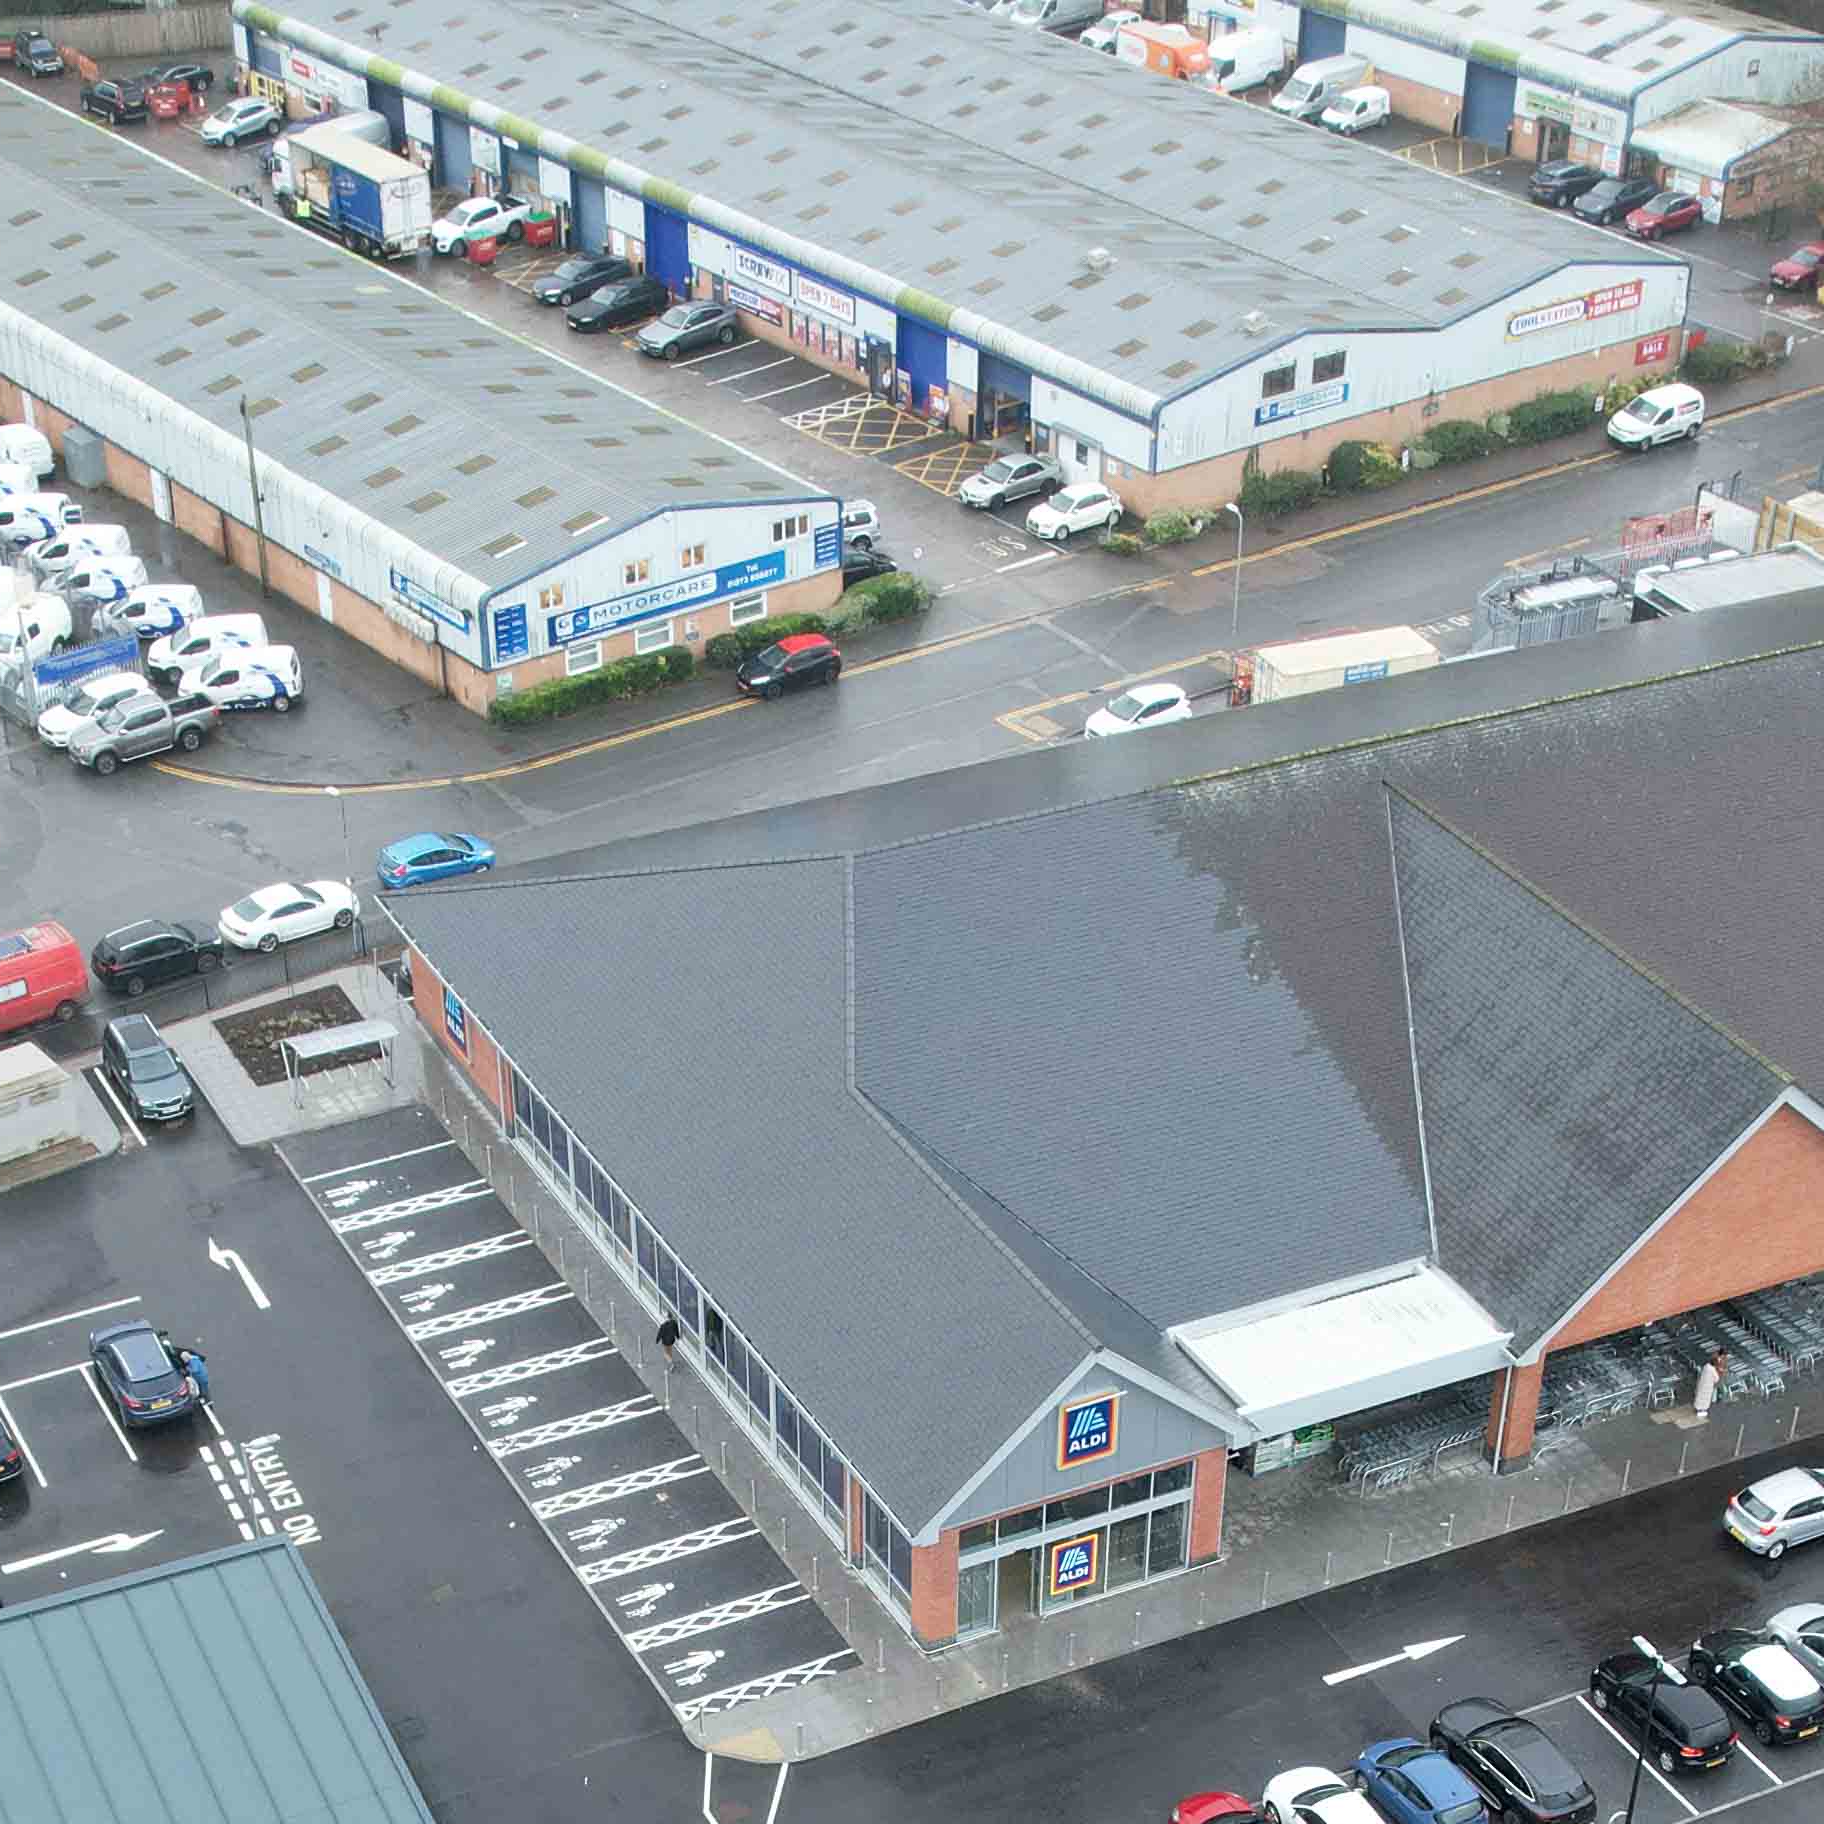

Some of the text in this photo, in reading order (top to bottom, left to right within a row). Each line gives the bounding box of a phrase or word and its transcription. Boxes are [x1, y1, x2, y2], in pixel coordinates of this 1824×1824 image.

[592, 578, 713, 622] MOTORCARE
[1068, 1431, 1107, 1454] ALDI
[245, 1446, 323, 1546] NO ENTRY
[1058, 1566, 1089, 1584] ALDI
